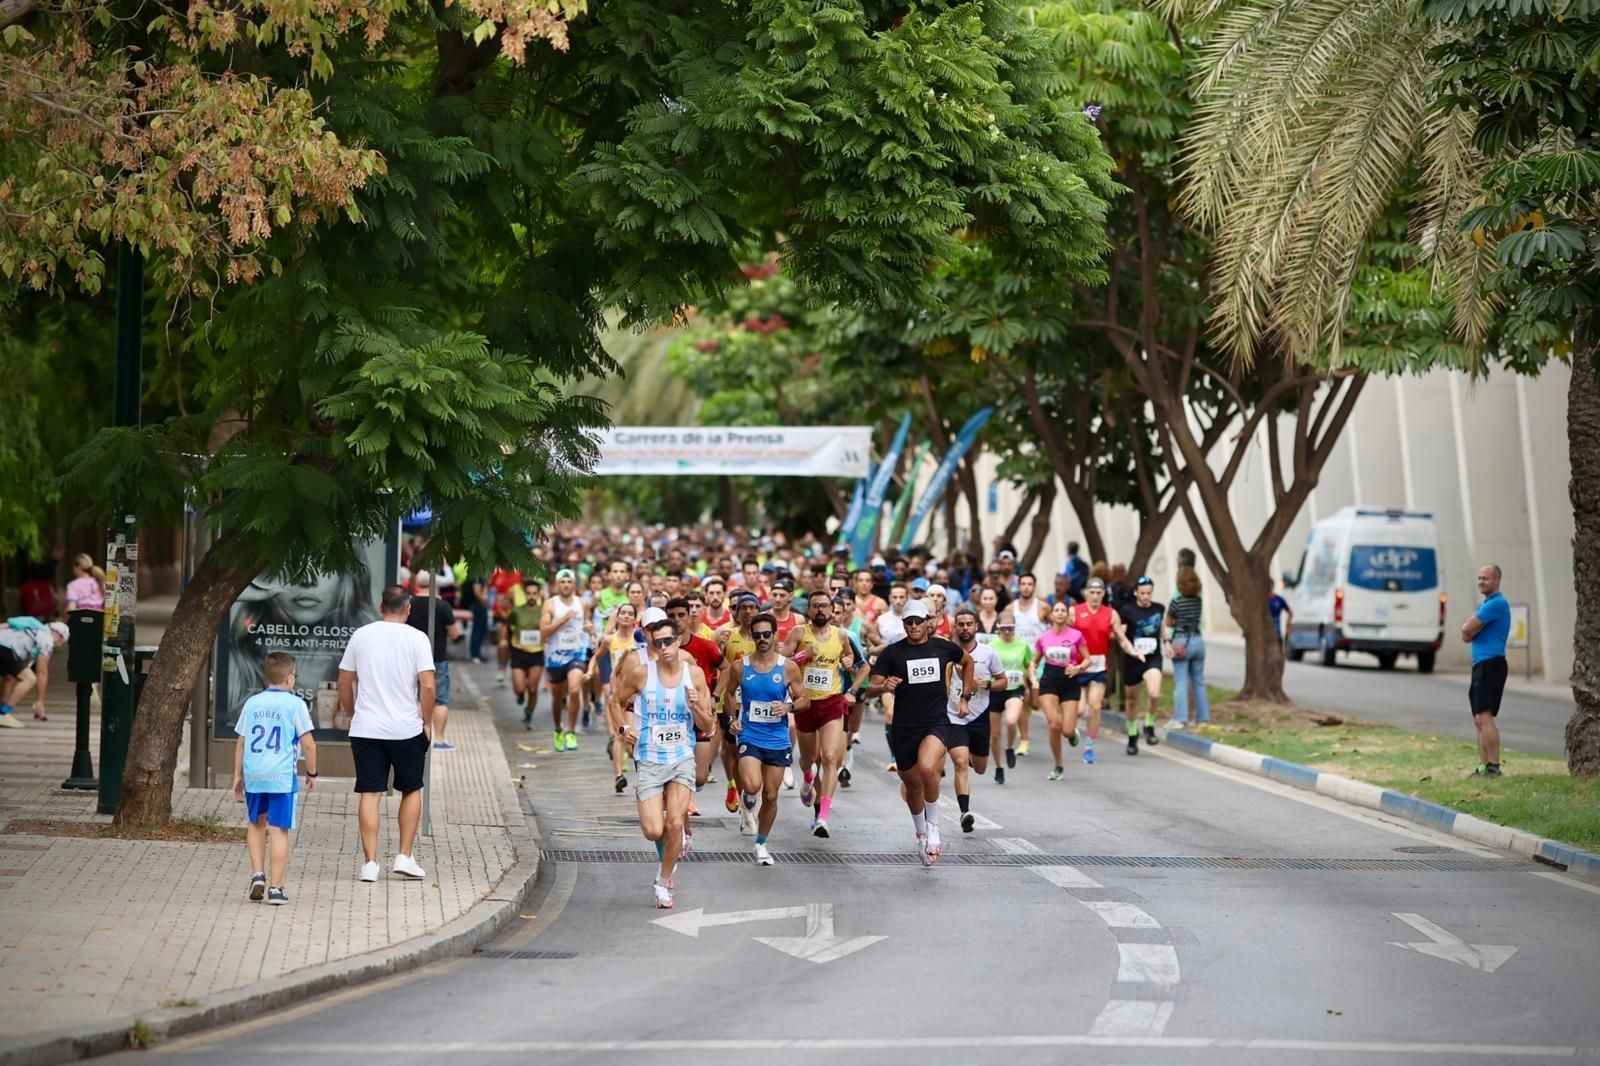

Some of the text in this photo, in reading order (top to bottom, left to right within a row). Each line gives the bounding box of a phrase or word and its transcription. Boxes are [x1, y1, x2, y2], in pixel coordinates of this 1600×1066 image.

[614, 432, 677, 445] Carrera
[682, 432, 703, 445] de
[727, 432, 784, 445] Prensa
[247, 624, 309, 636] CABELLO
[255, 638, 262, 646] 4
[265, 636, 290, 647] DÍAS
[912, 666, 935, 677] 859
[807, 674, 828, 684] 692
[250, 724, 282, 755] 24
[657, 731, 681, 742] 125
